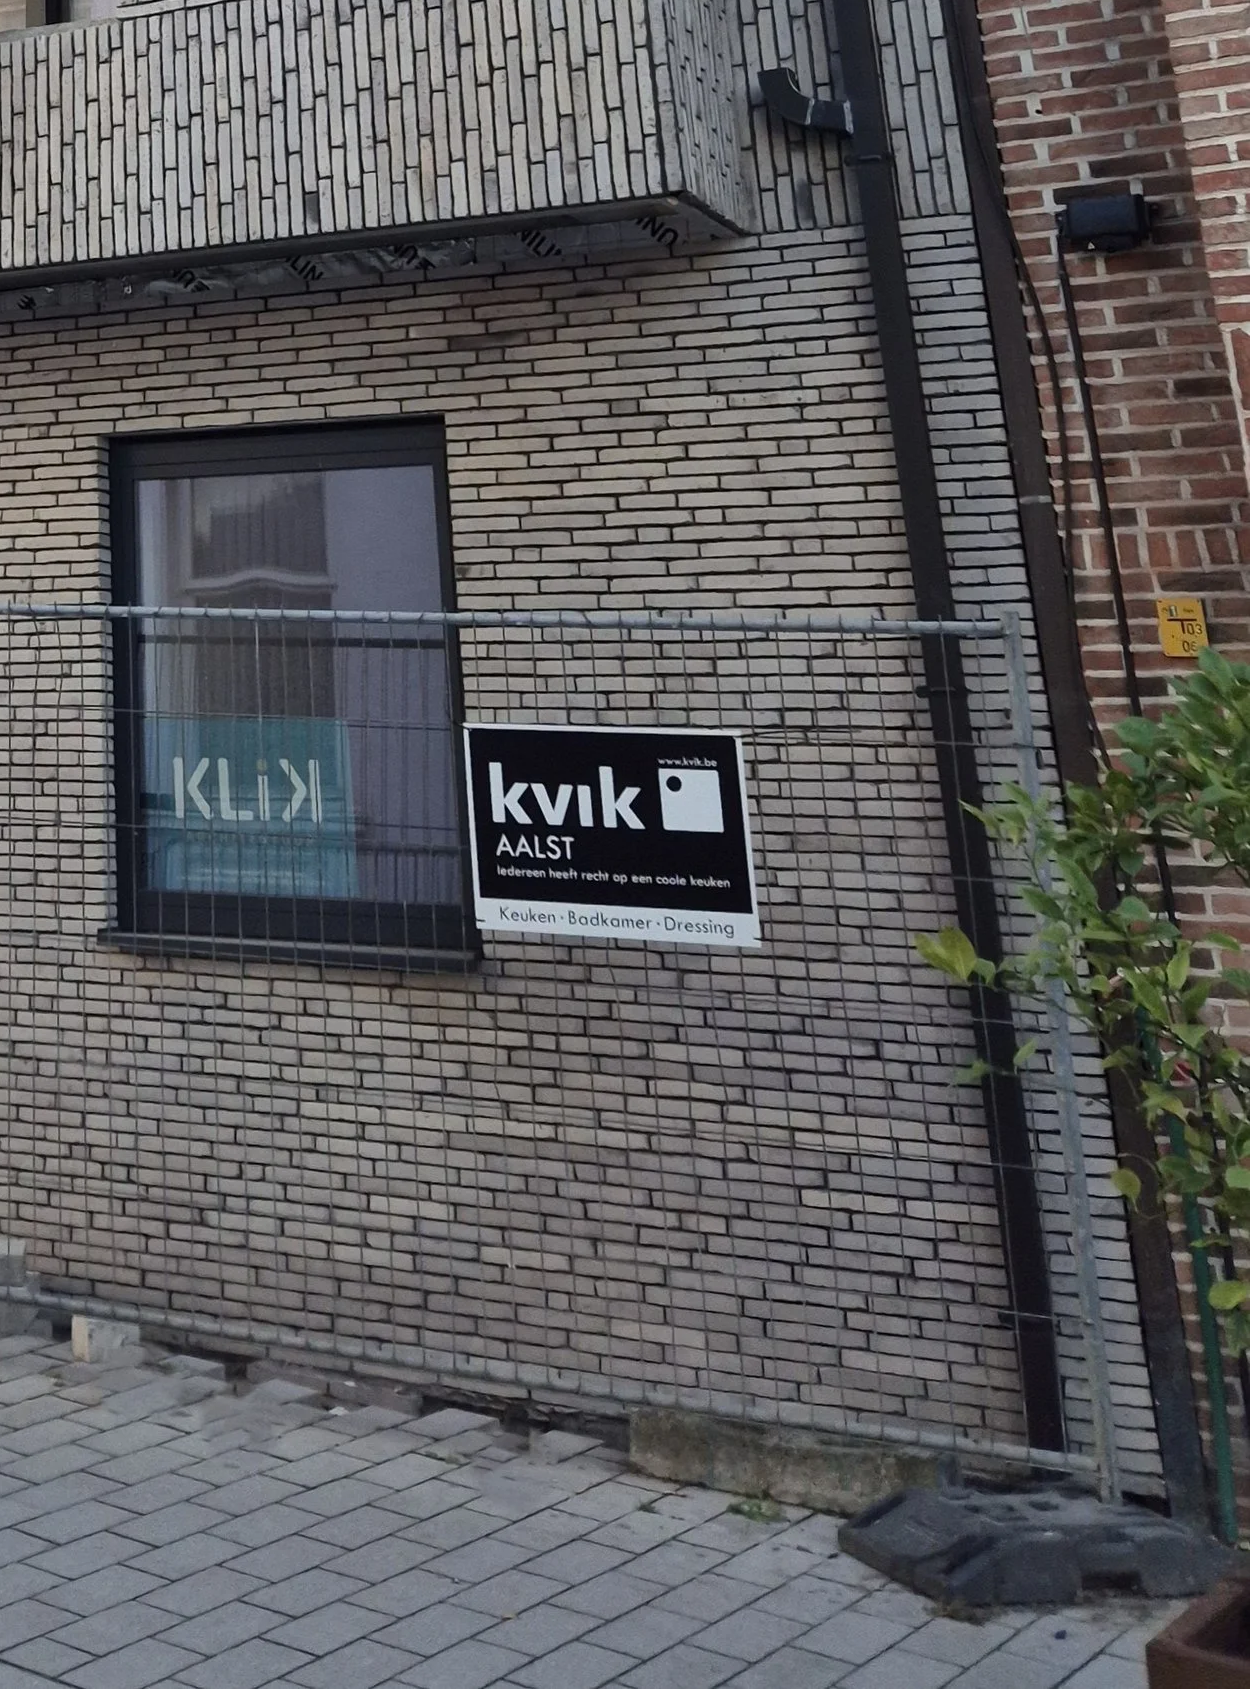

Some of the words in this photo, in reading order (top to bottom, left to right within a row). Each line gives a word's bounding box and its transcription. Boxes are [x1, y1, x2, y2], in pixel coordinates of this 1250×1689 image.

[657, 757, 718, 768] www.kvik.be
[488, 761, 646, 830] kvik
[496, 834, 575, 860] AALST
[497, 865, 546, 878] Iedereen
[549, 867, 578, 880] heeft
[581, 870, 610, 882] recht
[613, 874, 628, 885] op
[631, 874, 653, 885] een
[655, 874, 687, 887] coole
[690, 876, 731, 889] keuken
[499, 906, 556, 924] Keuken
[568, 909, 654, 930] Badkamer
[664, 915, 735, 938] Dressing
